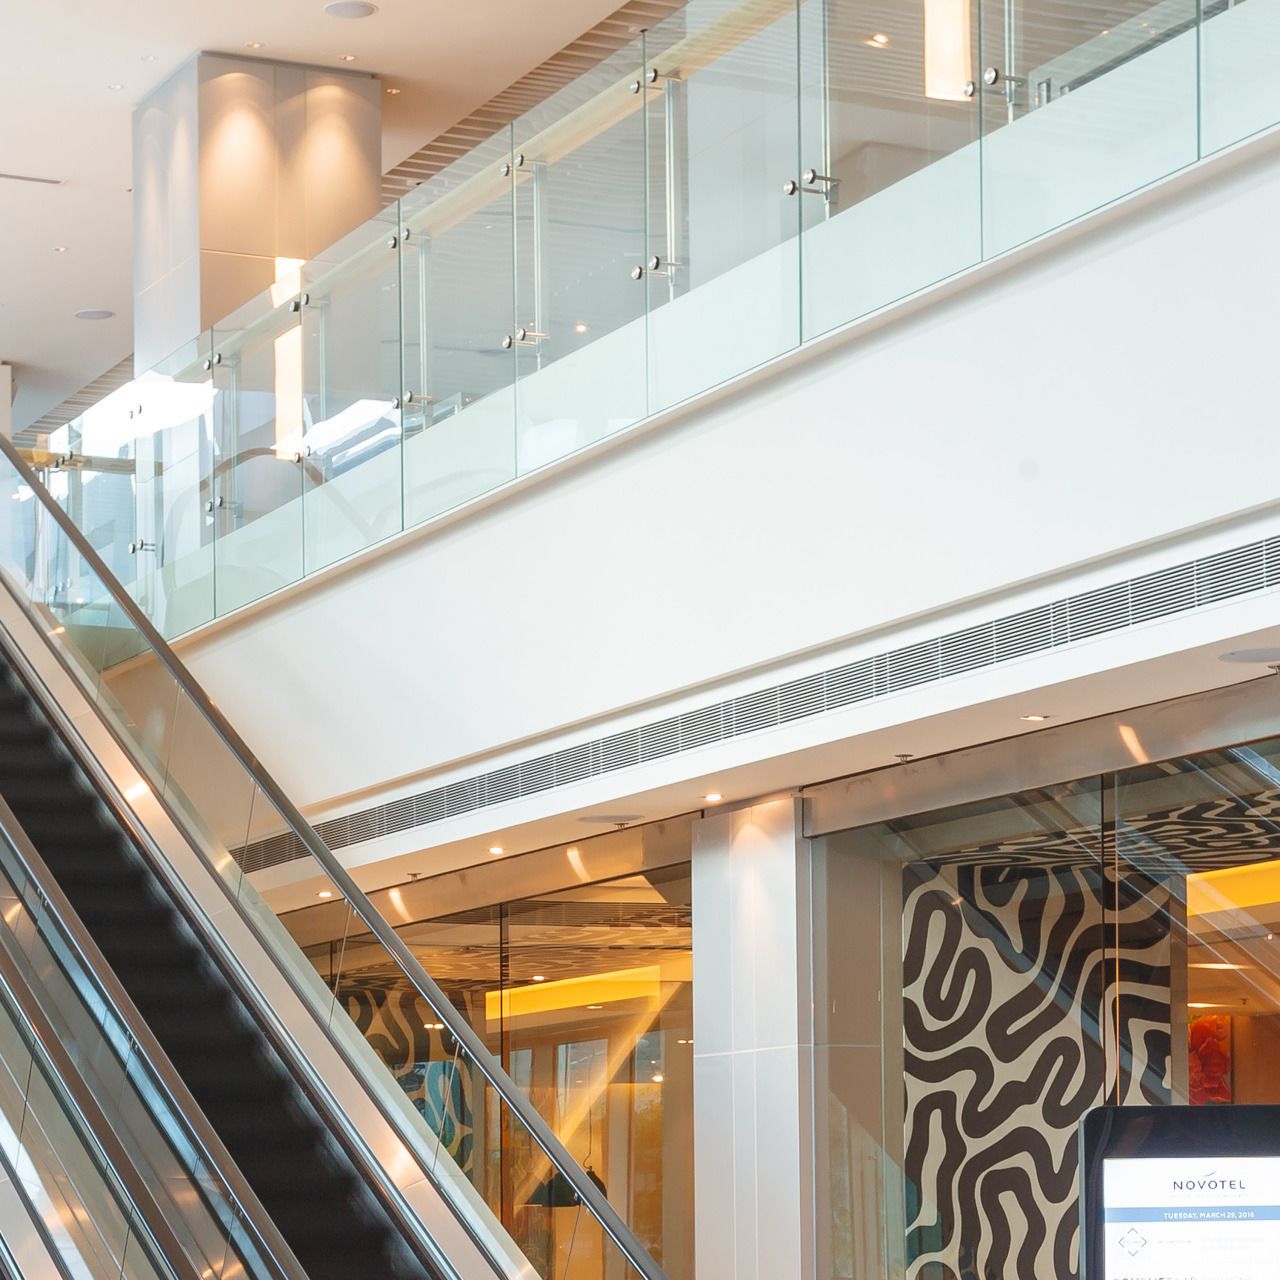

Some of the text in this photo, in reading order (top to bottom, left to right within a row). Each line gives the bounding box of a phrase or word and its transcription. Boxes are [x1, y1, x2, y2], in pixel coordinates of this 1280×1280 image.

[1173, 1179, 1246, 1190] NOVOTEL
[1163, 1211, 1198, 1220] TUESDAY,
[1199, 1211, 1225, 1219] MARCH
